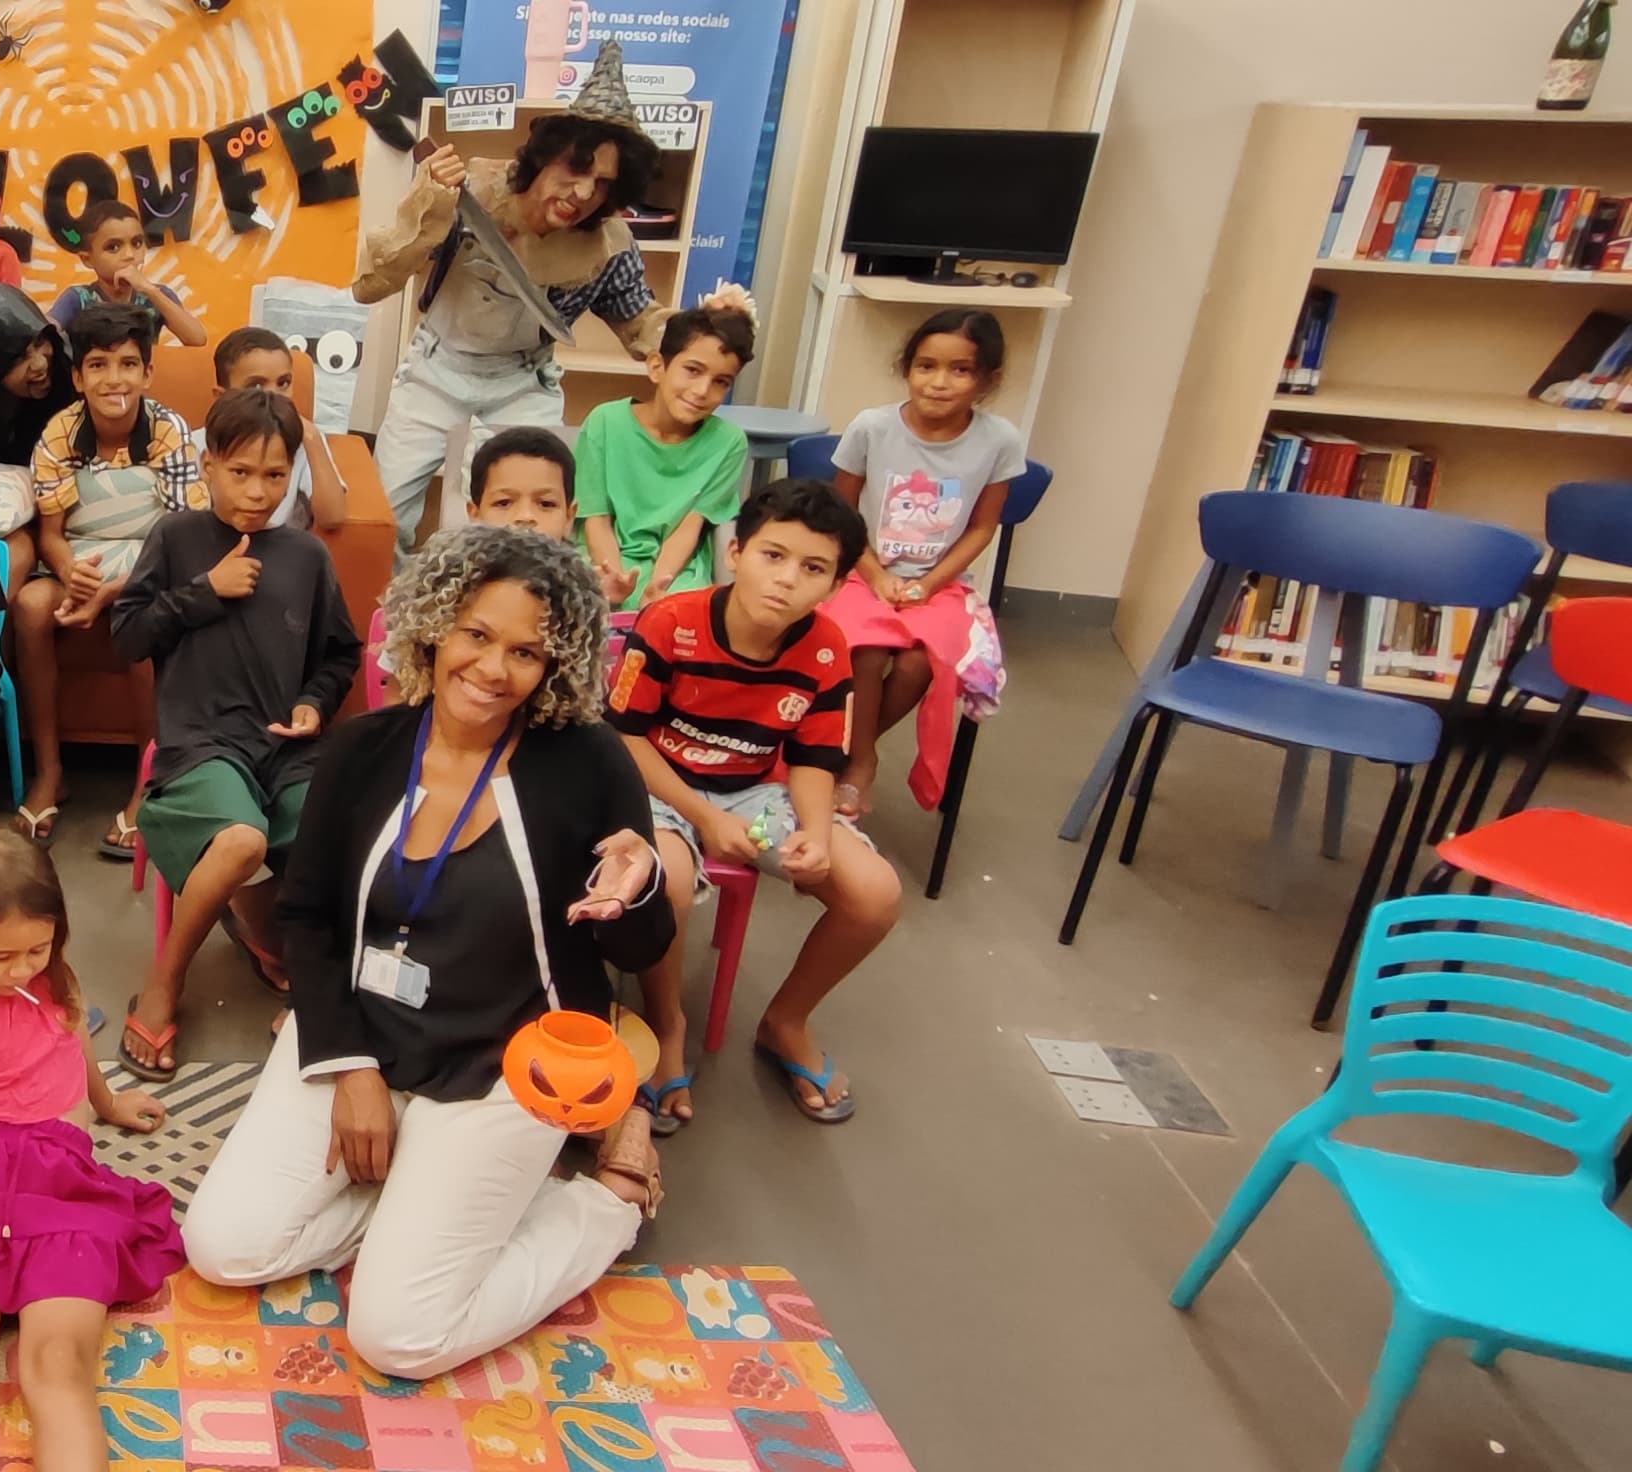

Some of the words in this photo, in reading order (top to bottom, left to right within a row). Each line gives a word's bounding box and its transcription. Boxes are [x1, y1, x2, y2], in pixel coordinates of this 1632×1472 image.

[609, 13, 634, 25] nas
[638, 12, 679, 27] redes
[682, 13, 730, 28] sociais
[615, 29, 657, 43] nosso
[660, 28, 692, 44] site:
[452, 87, 511, 107] AVISO
[635, 104, 694, 122] AVISO
[882, 541, 940, 556] #SELFIE
